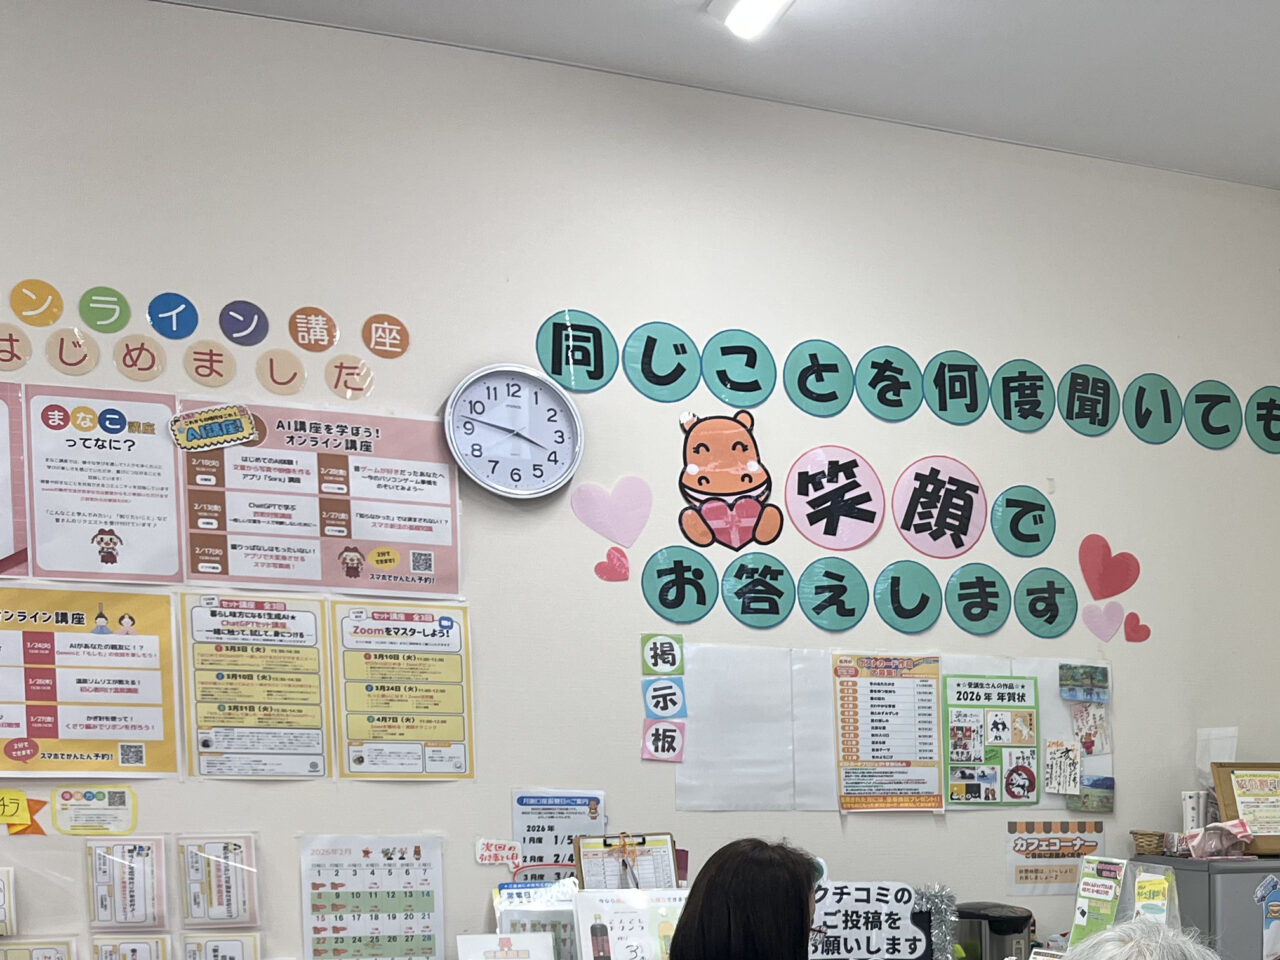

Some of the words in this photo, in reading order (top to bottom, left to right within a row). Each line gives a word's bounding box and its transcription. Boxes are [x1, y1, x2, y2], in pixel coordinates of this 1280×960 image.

[22, 287, 402, 353] ンライン講座
[0, 332, 366, 395] はじめました
[486, 386, 498, 400] 11
[505, 382, 522, 398] 12
[533, 391, 539, 405] 1
[468, 400, 485, 416] 10
[547, 408, 558, 424] 2
[276, 420, 381, 438] AI講座を学ぼう！
[463, 420, 475, 435] 9
[65, 437, 136, 452] ってなに？
[286, 435, 373, 452] オンライン講座
[554, 430, 565, 444] 3
[470, 443, 483, 458] 8
[547, 450, 559, 465] 4
[487, 460, 500, 475] 7
[510, 467, 522, 482] 6
[532, 464, 544, 478] 5
[797, 458, 1045, 549] 笑顔で
[656, 560, 1064, 624] お答えします
[352, 625, 450, 638] Zoomをマスターしよう！
[650, 642, 678, 753] 掲示板
[996, 691, 1026, 703] 年賀状
[1013, 837, 1099, 851] カフェコーナー
[815, 885, 912, 905] クチコミの
[822, 910, 902, 931] ご投稿を
